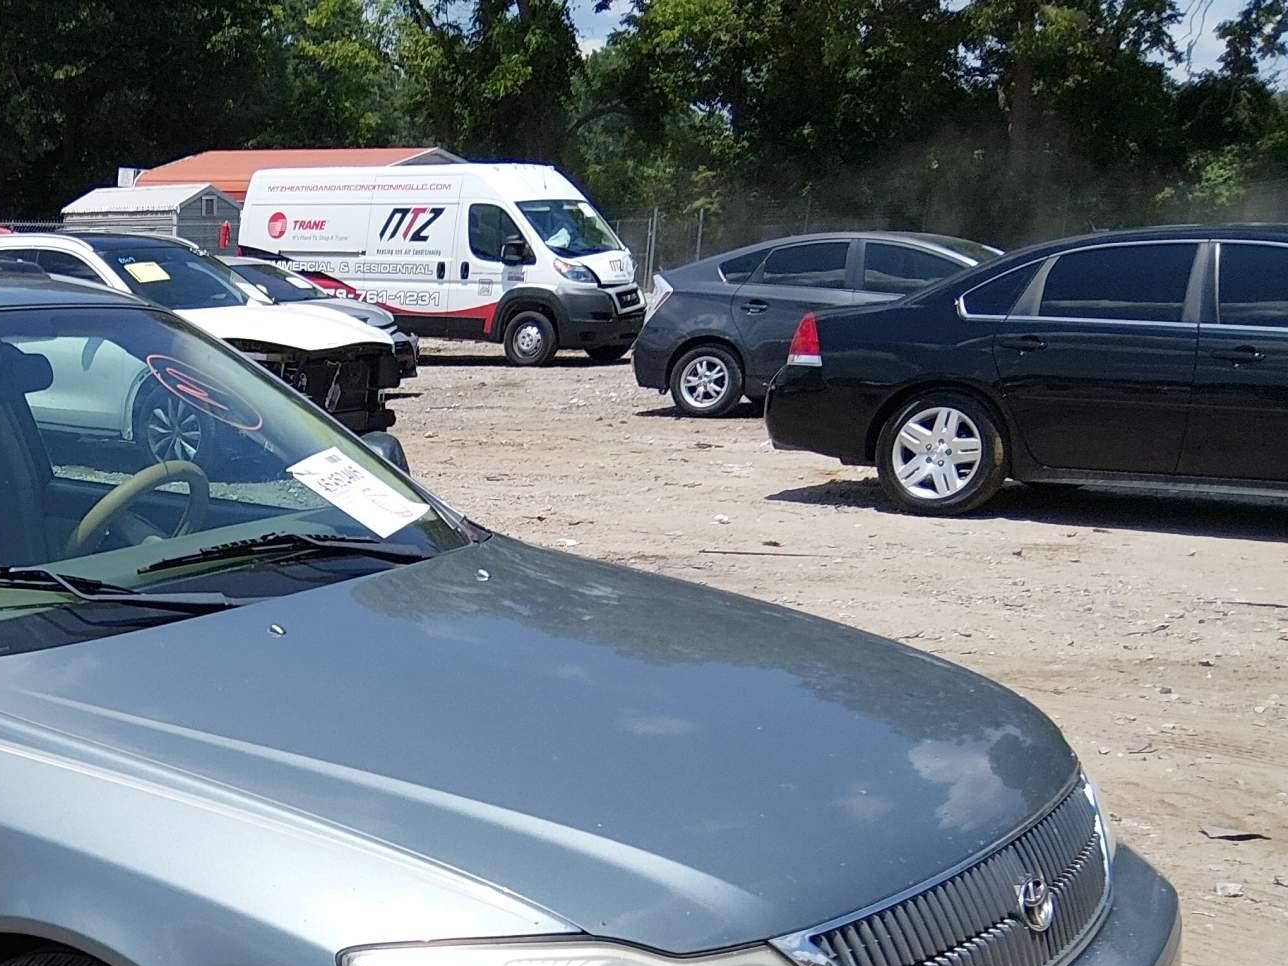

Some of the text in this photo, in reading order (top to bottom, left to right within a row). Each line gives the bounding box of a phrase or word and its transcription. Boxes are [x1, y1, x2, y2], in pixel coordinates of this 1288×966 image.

[293, 220, 326, 231] TRANE
[379, 207, 446, 242] MTZ
[412, 249, 441, 257] Conditioning
[271, 260, 433, 275] MMERCIAL & RESIDENTIAL
